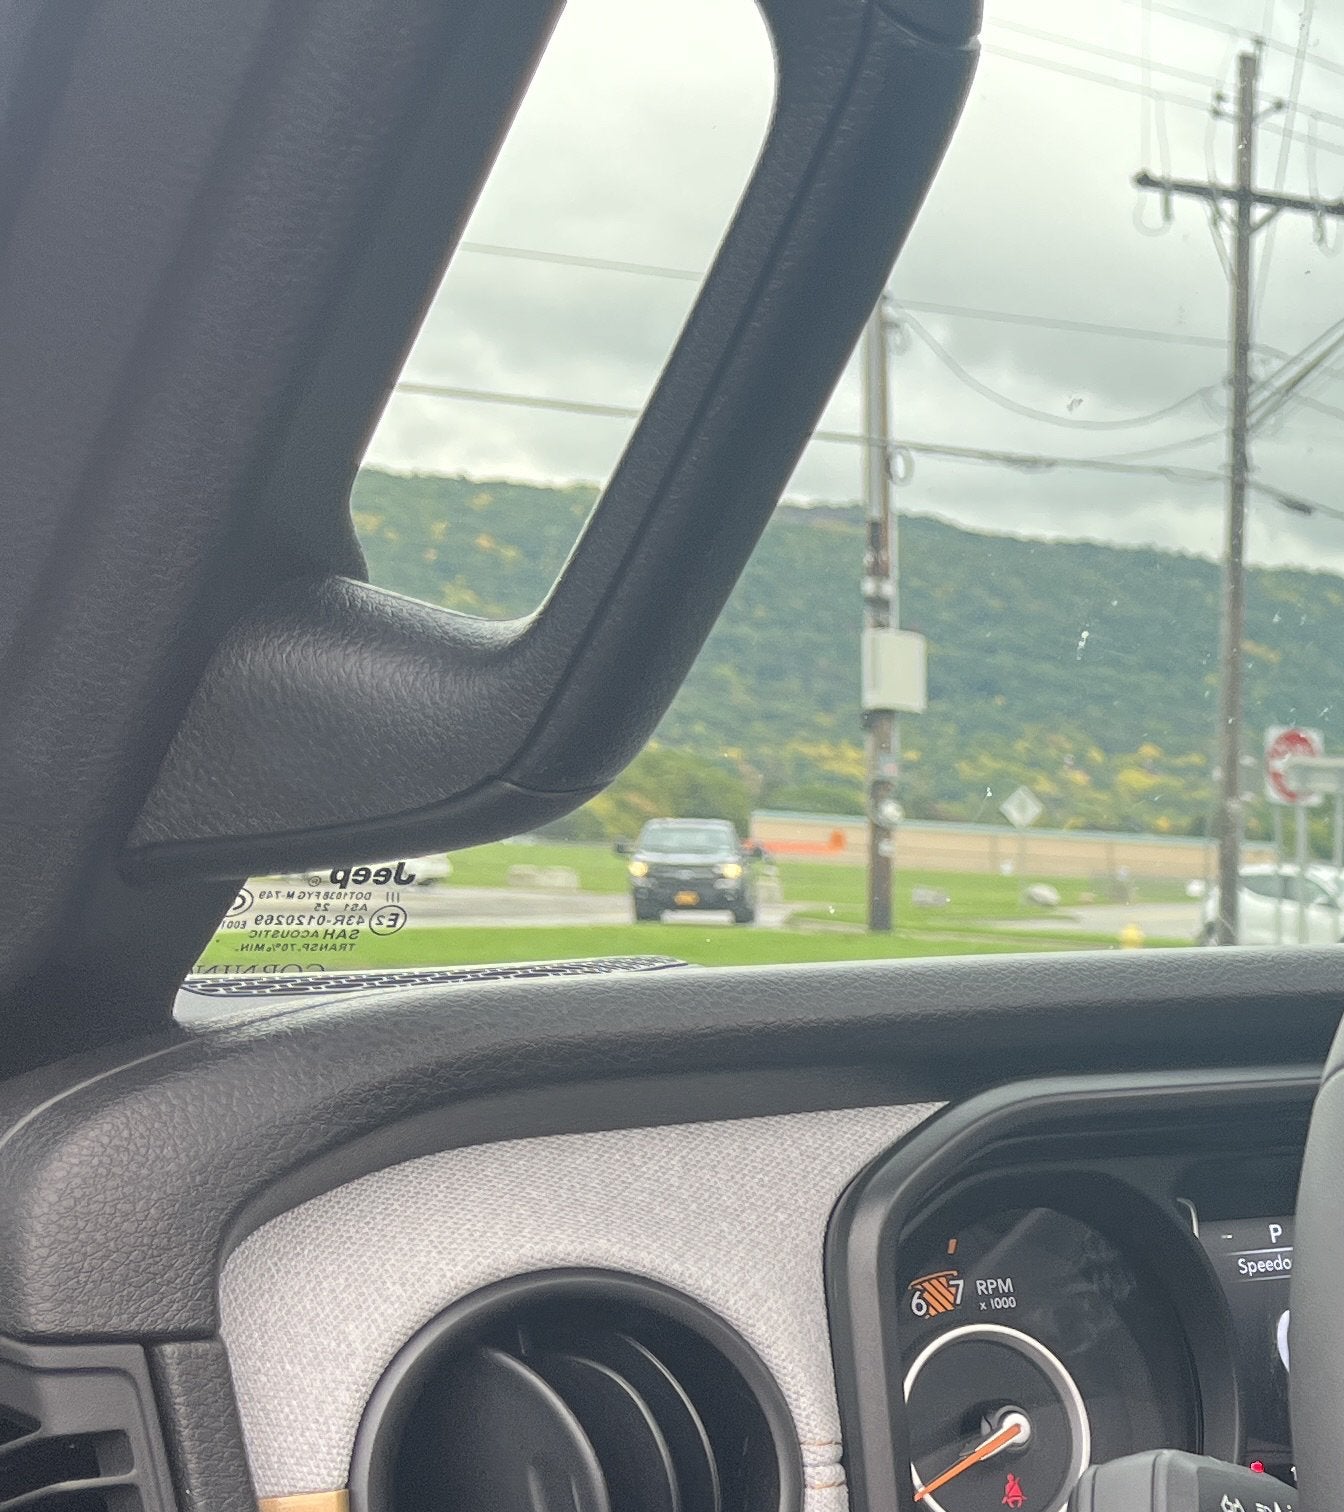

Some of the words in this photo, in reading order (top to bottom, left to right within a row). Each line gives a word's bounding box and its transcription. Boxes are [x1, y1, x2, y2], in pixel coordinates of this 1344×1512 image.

[1268, 1223, 1283, 1244] P
[1238, 1253, 1292, 1277] Speedo
[949, 1279, 964, 1305] 7
[976, 1278, 1014, 1296] RPM
[911, 1290, 928, 1317] 6
[990, 1296, 1017, 1310] 1000
